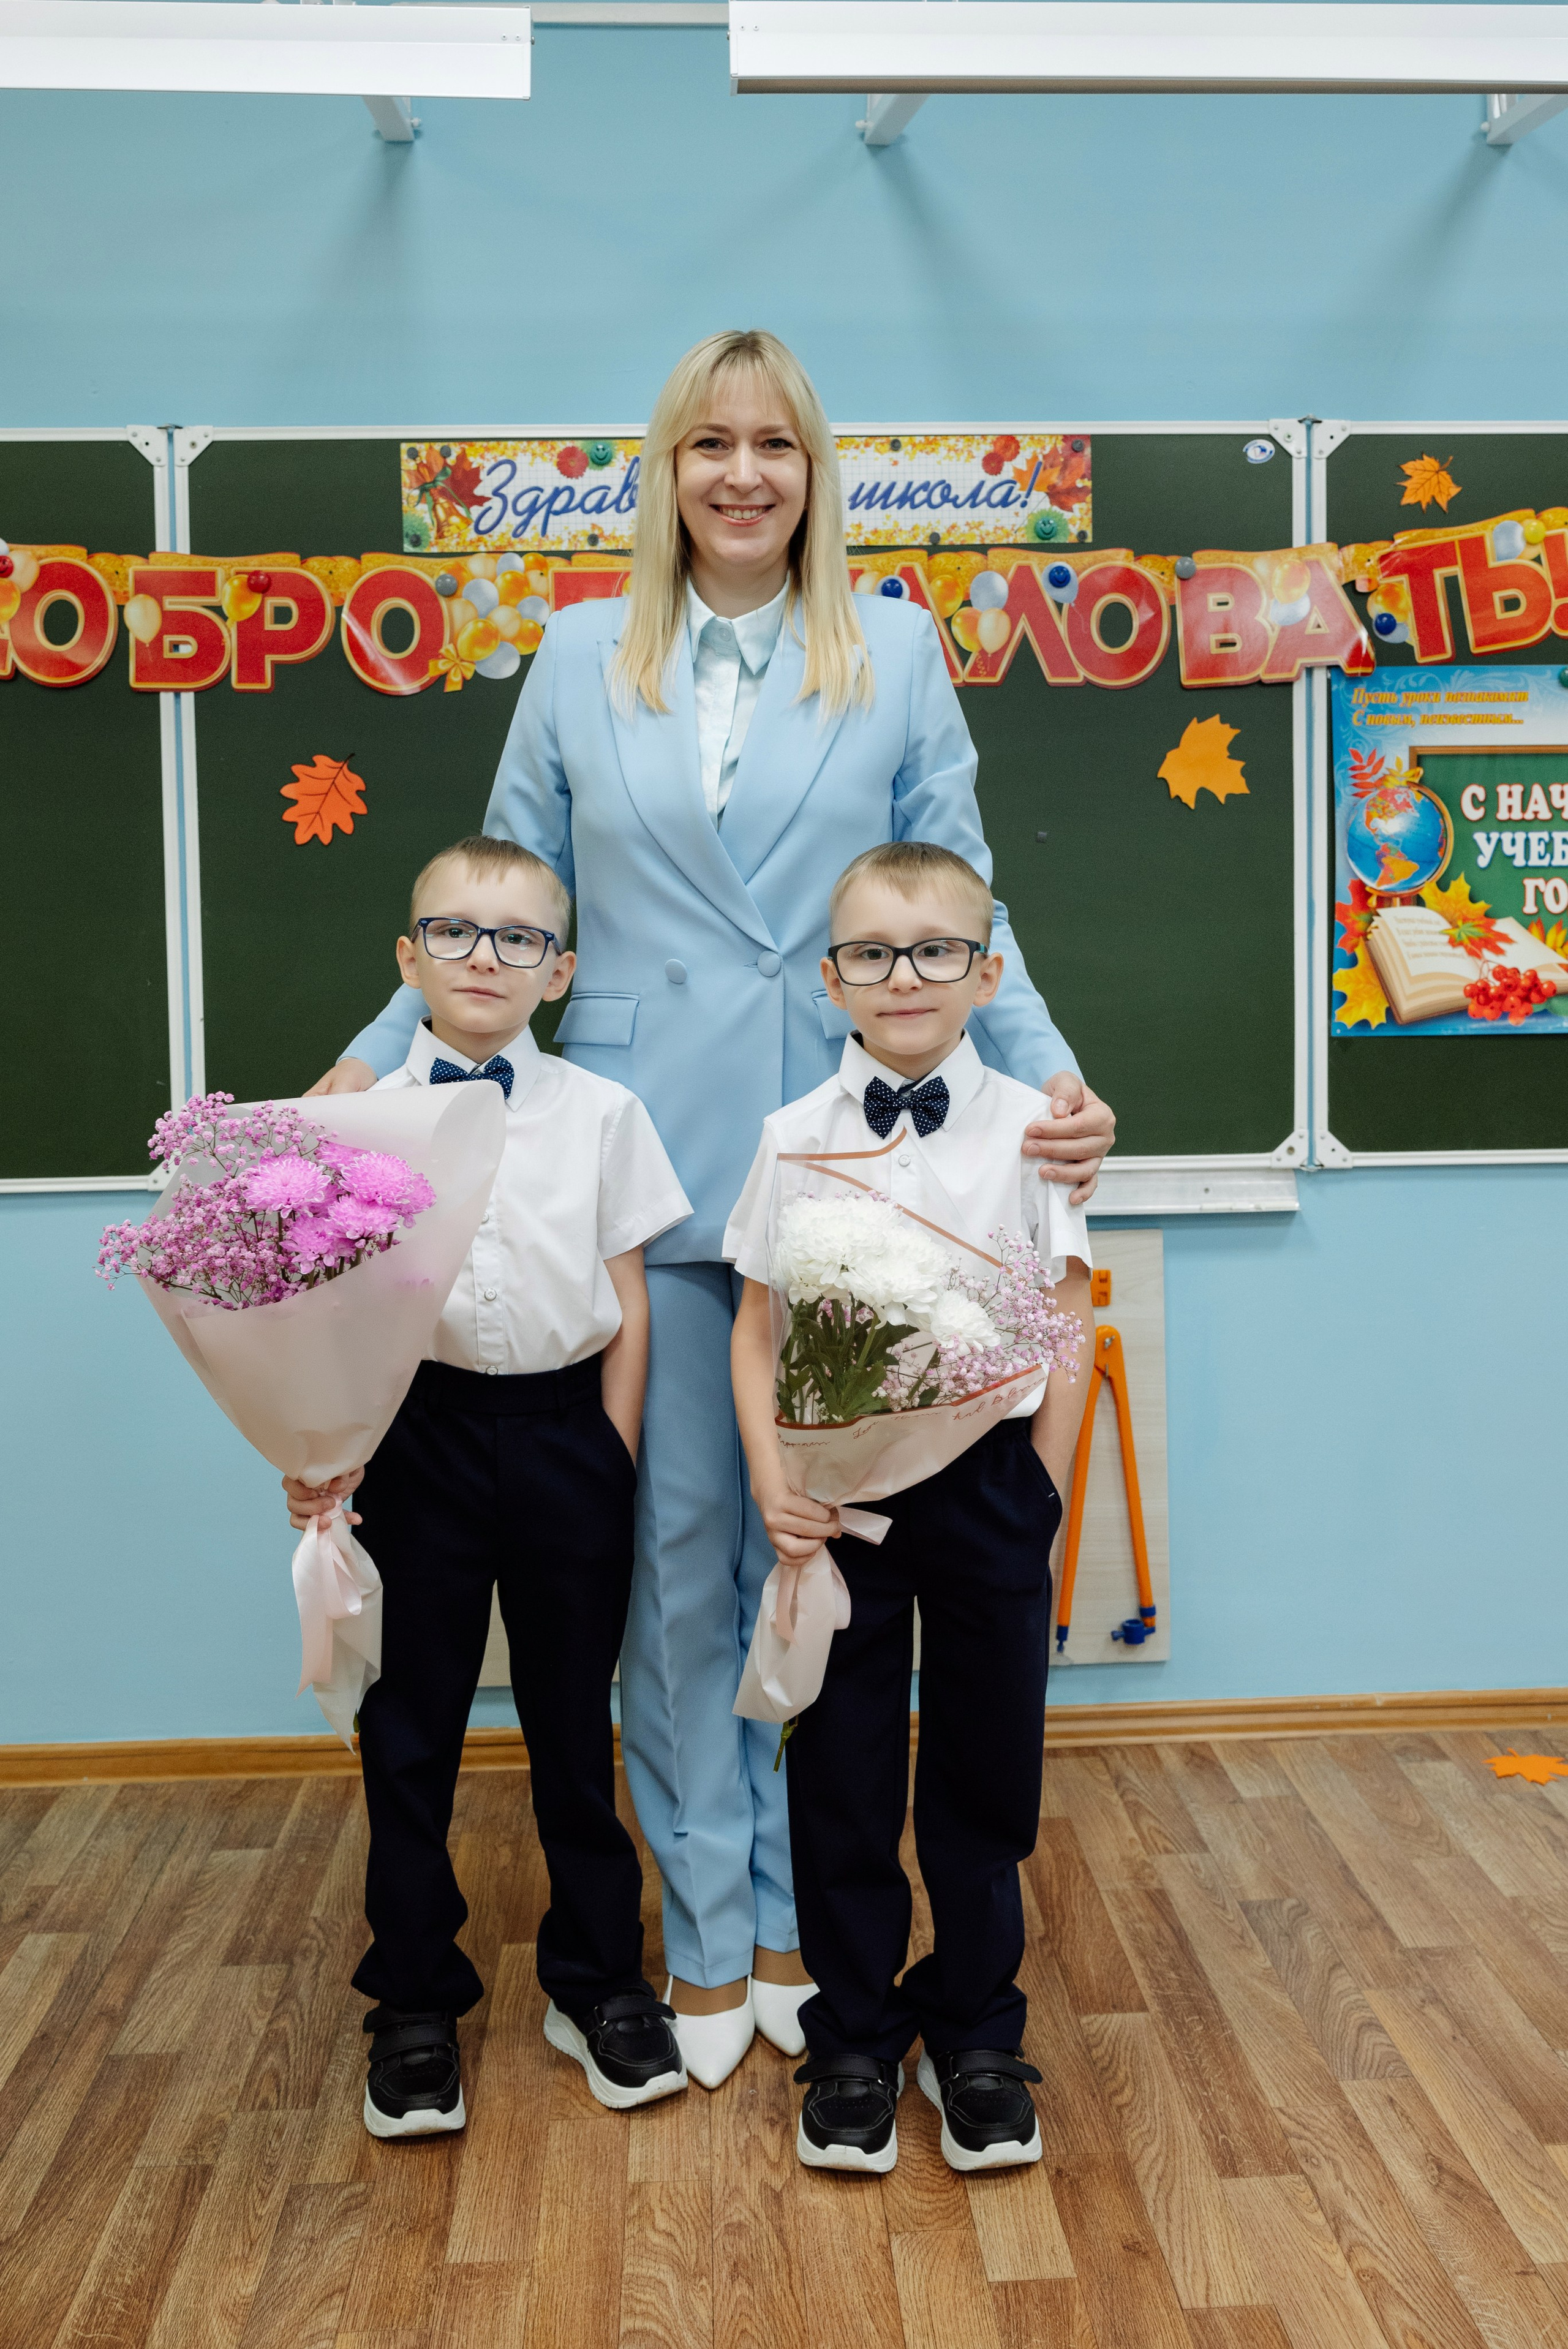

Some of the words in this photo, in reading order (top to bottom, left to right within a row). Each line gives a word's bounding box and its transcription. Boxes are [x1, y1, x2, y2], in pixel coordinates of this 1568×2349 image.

[848, 461, 1042, 510] школа!
[0, 556, 451, 695] ОБРО
[1351, 687, 1398, 707] Пусть
[1399, 692, 1441, 707] уроки
[1352, 709, 1365, 726] С
[1366, 714, 1415, 728] новым,
[1460, 783, 1487, 822] С
[1521, 876, 1568, 915] ГО
